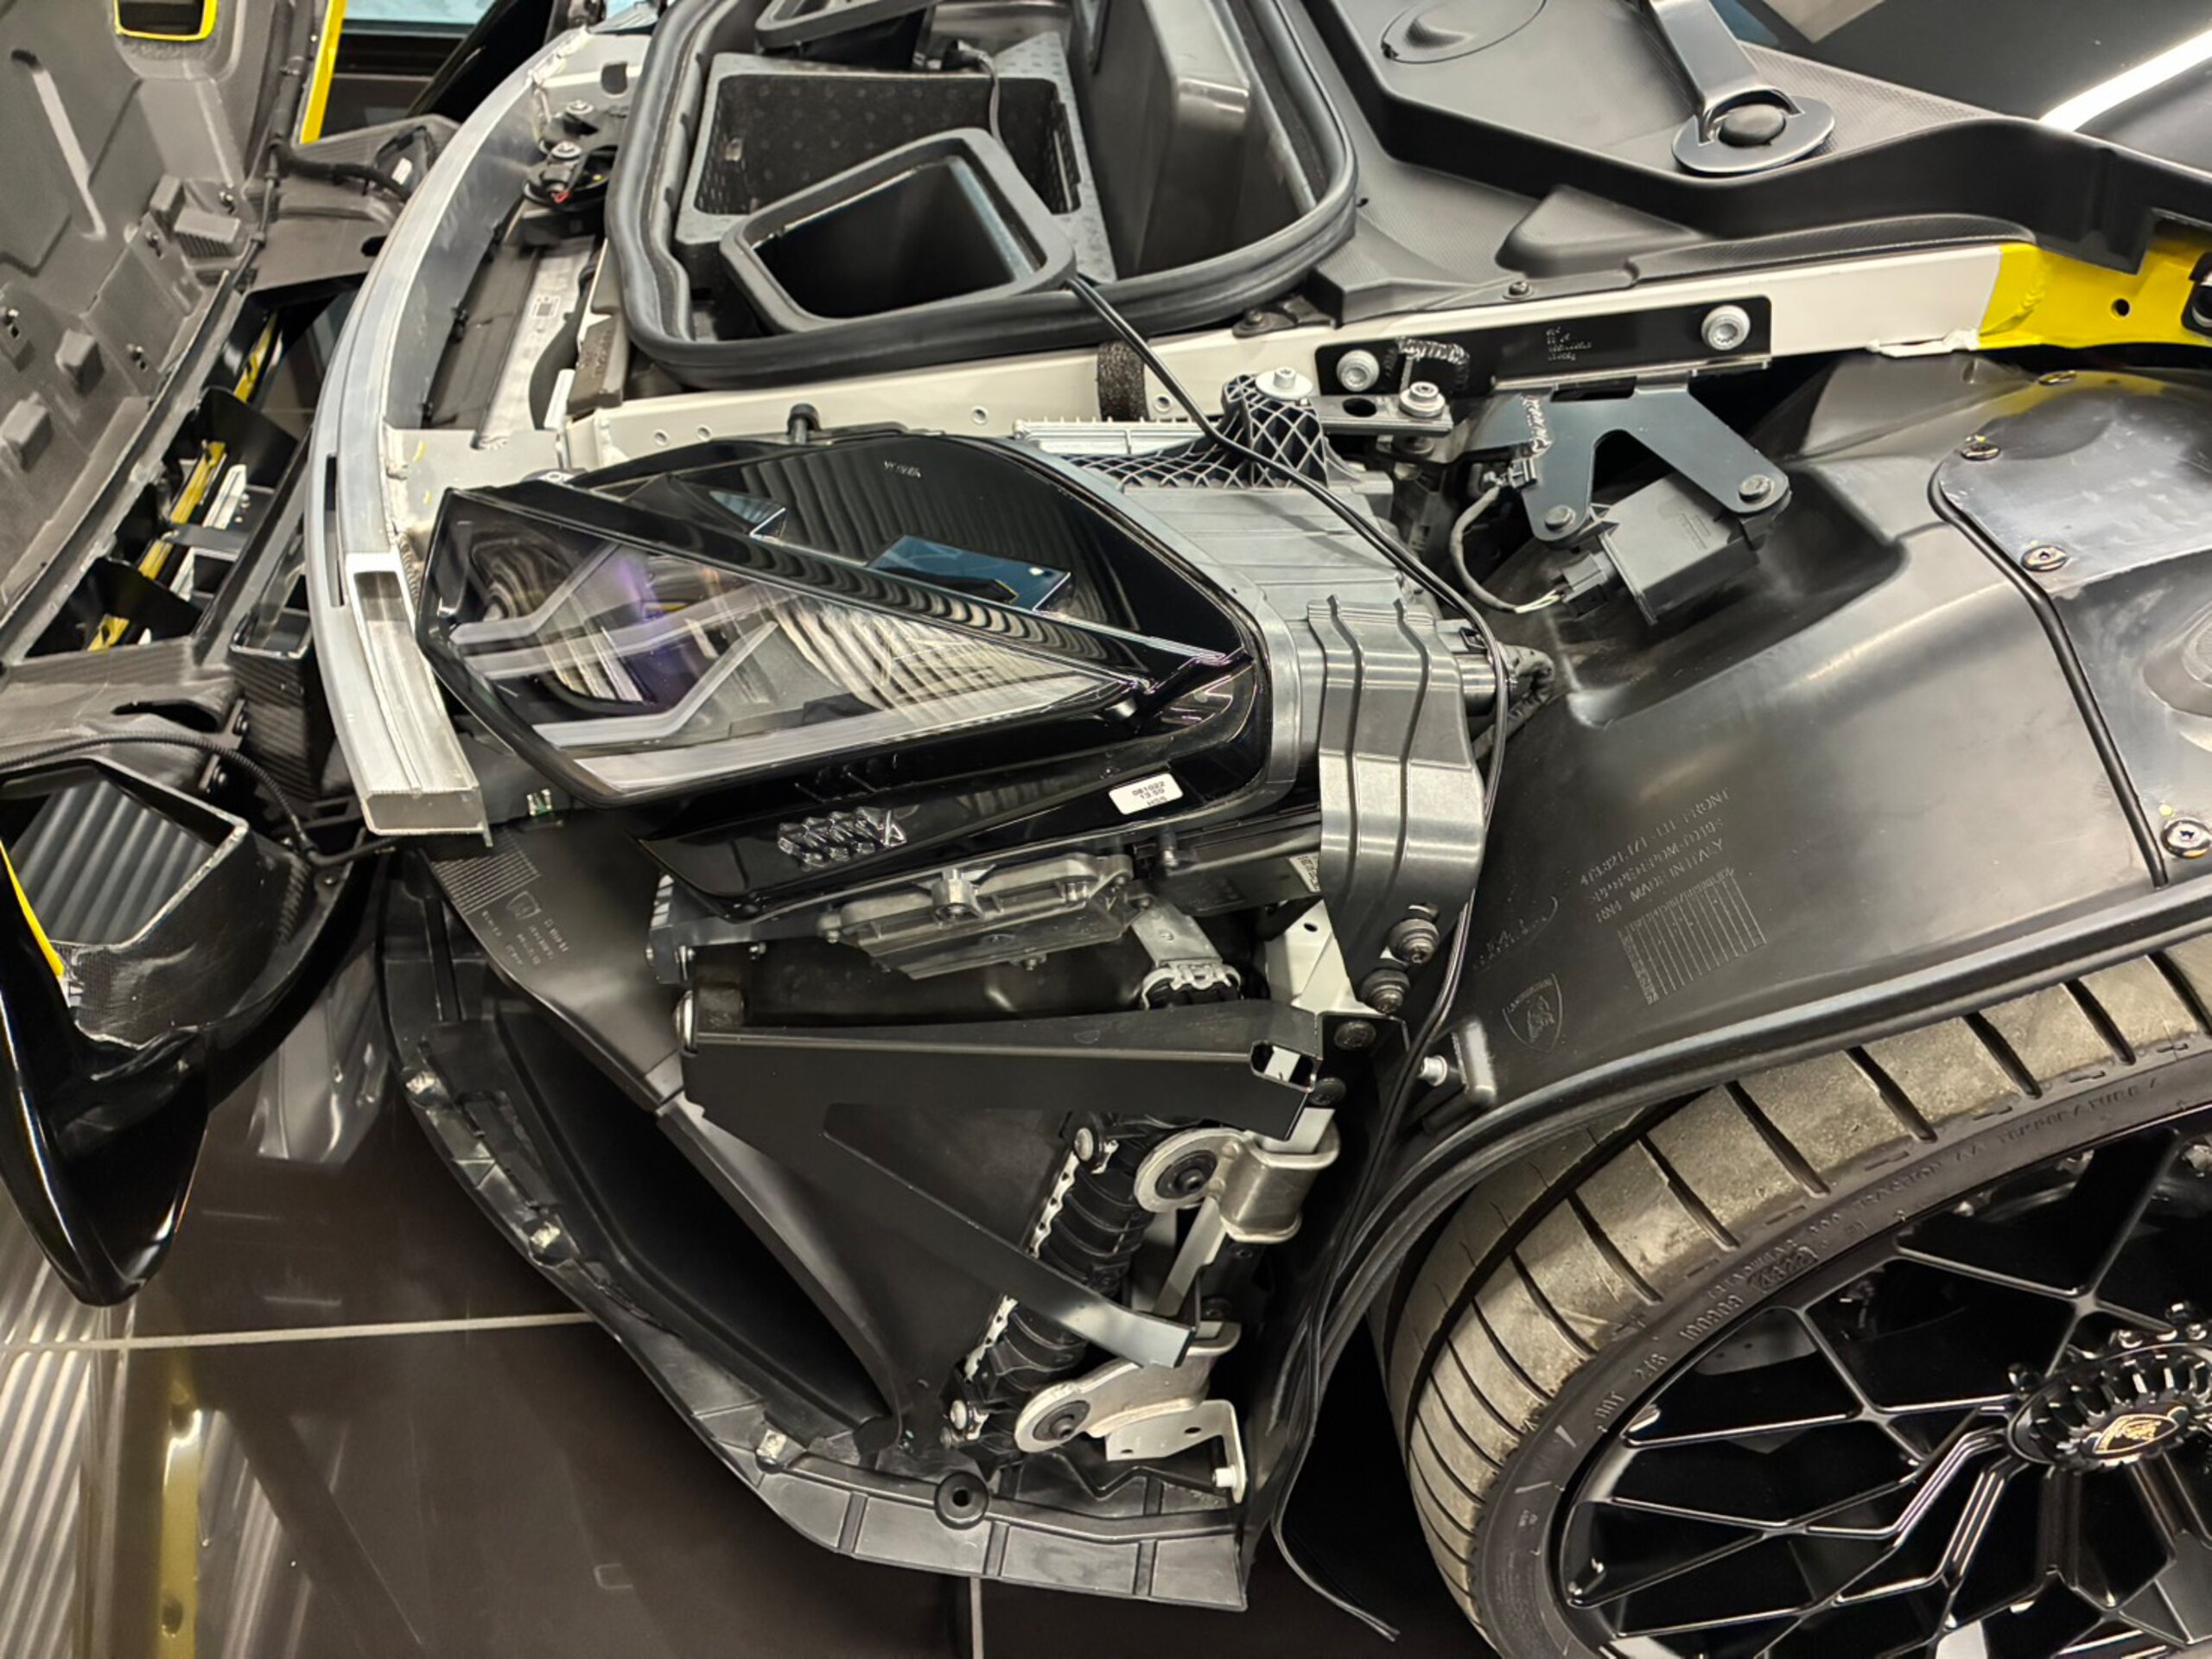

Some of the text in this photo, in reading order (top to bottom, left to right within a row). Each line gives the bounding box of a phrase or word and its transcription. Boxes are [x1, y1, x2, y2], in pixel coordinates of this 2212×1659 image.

[1682, 787, 1732, 823] FRONT
[1630, 871, 1669, 902] MADE
[1669, 864, 1685, 879] IN
[1686, 838, 1724, 870] ITALY
